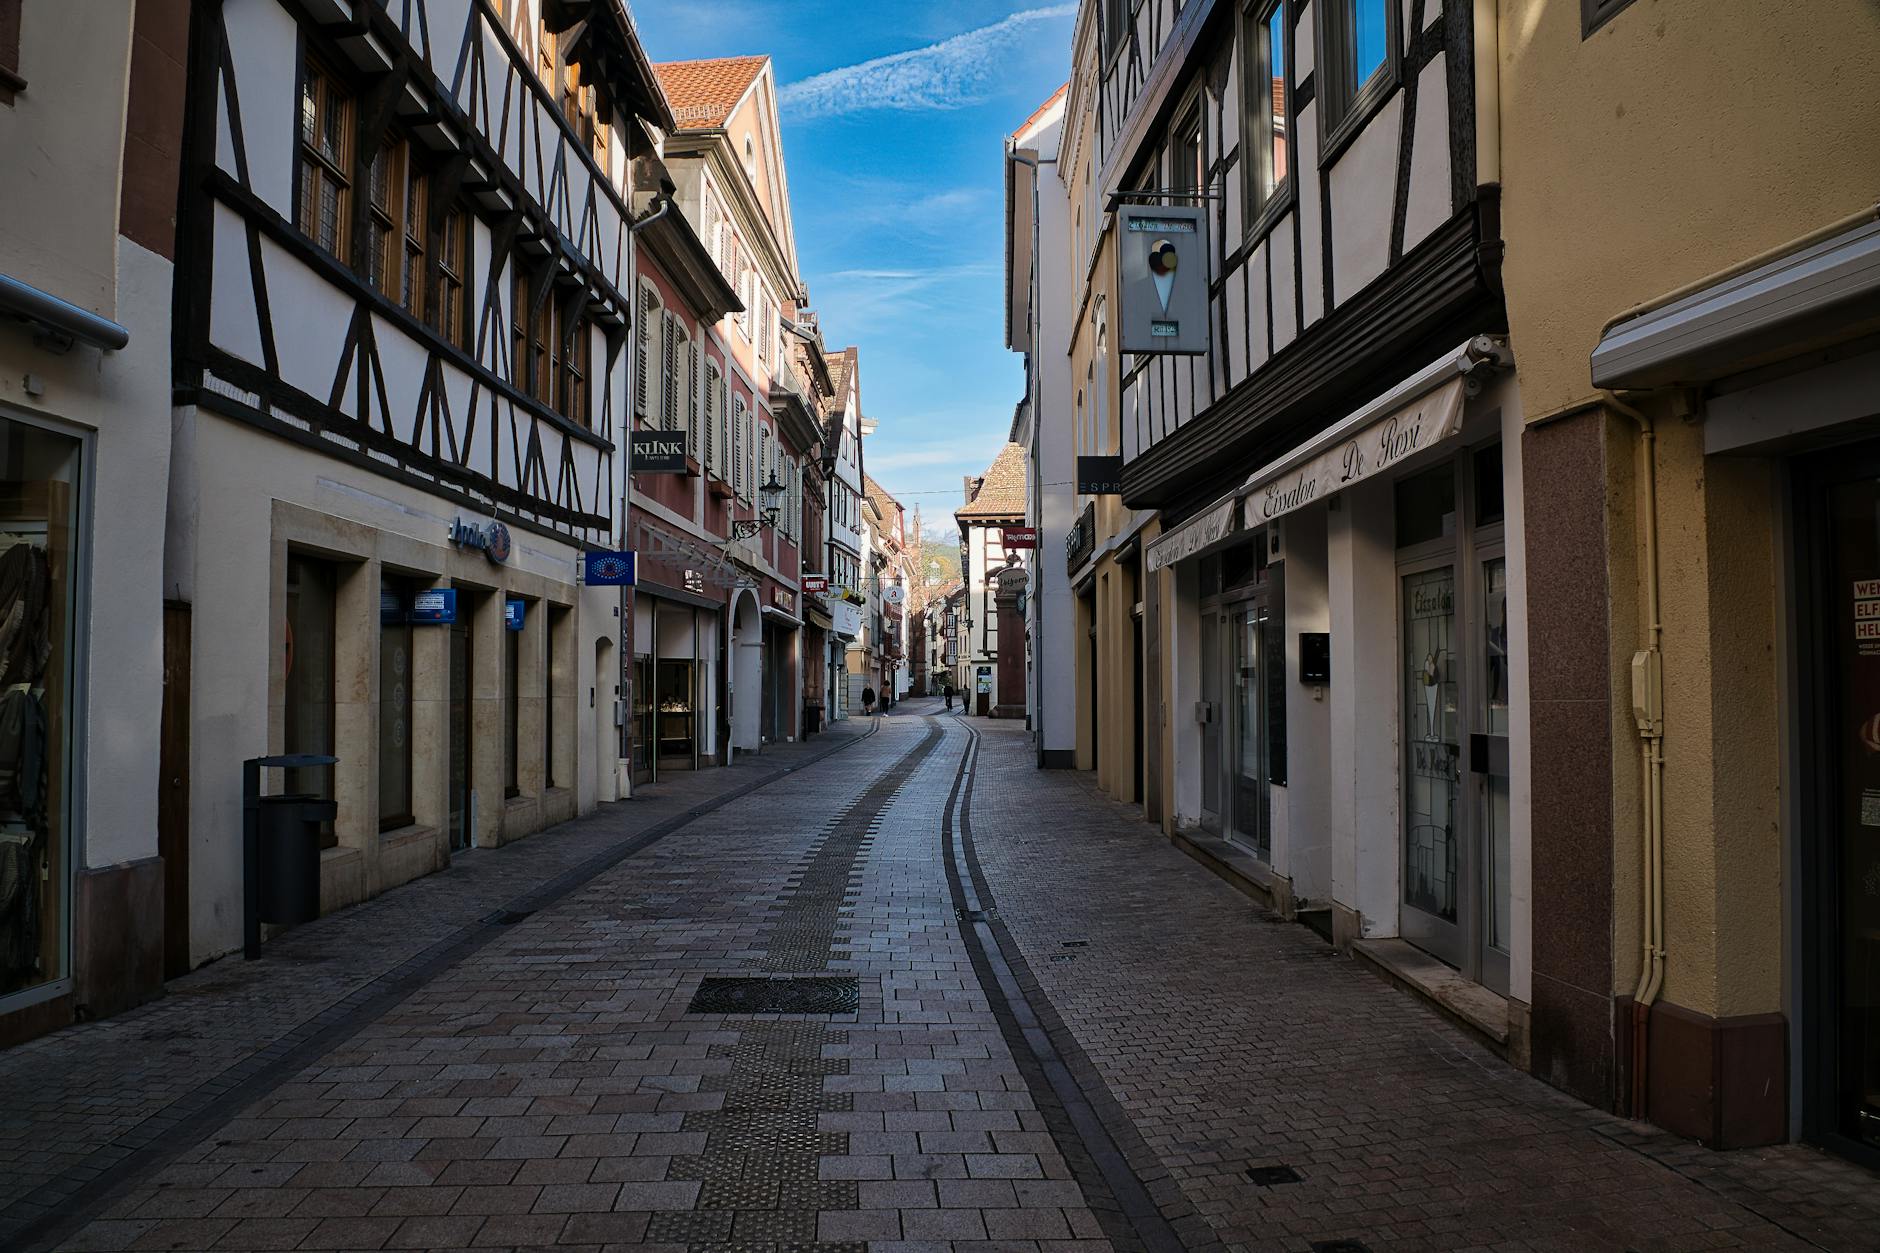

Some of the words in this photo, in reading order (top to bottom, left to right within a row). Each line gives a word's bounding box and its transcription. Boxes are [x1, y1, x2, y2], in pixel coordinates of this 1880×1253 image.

[633, 440, 683, 456] KLINK
[1263, 473, 1316, 518] Eissalon
[1341, 440, 1364, 483] De
[1377, 414, 1422, 468] Rossi
[1415, 586, 1451, 615] Eissalon
